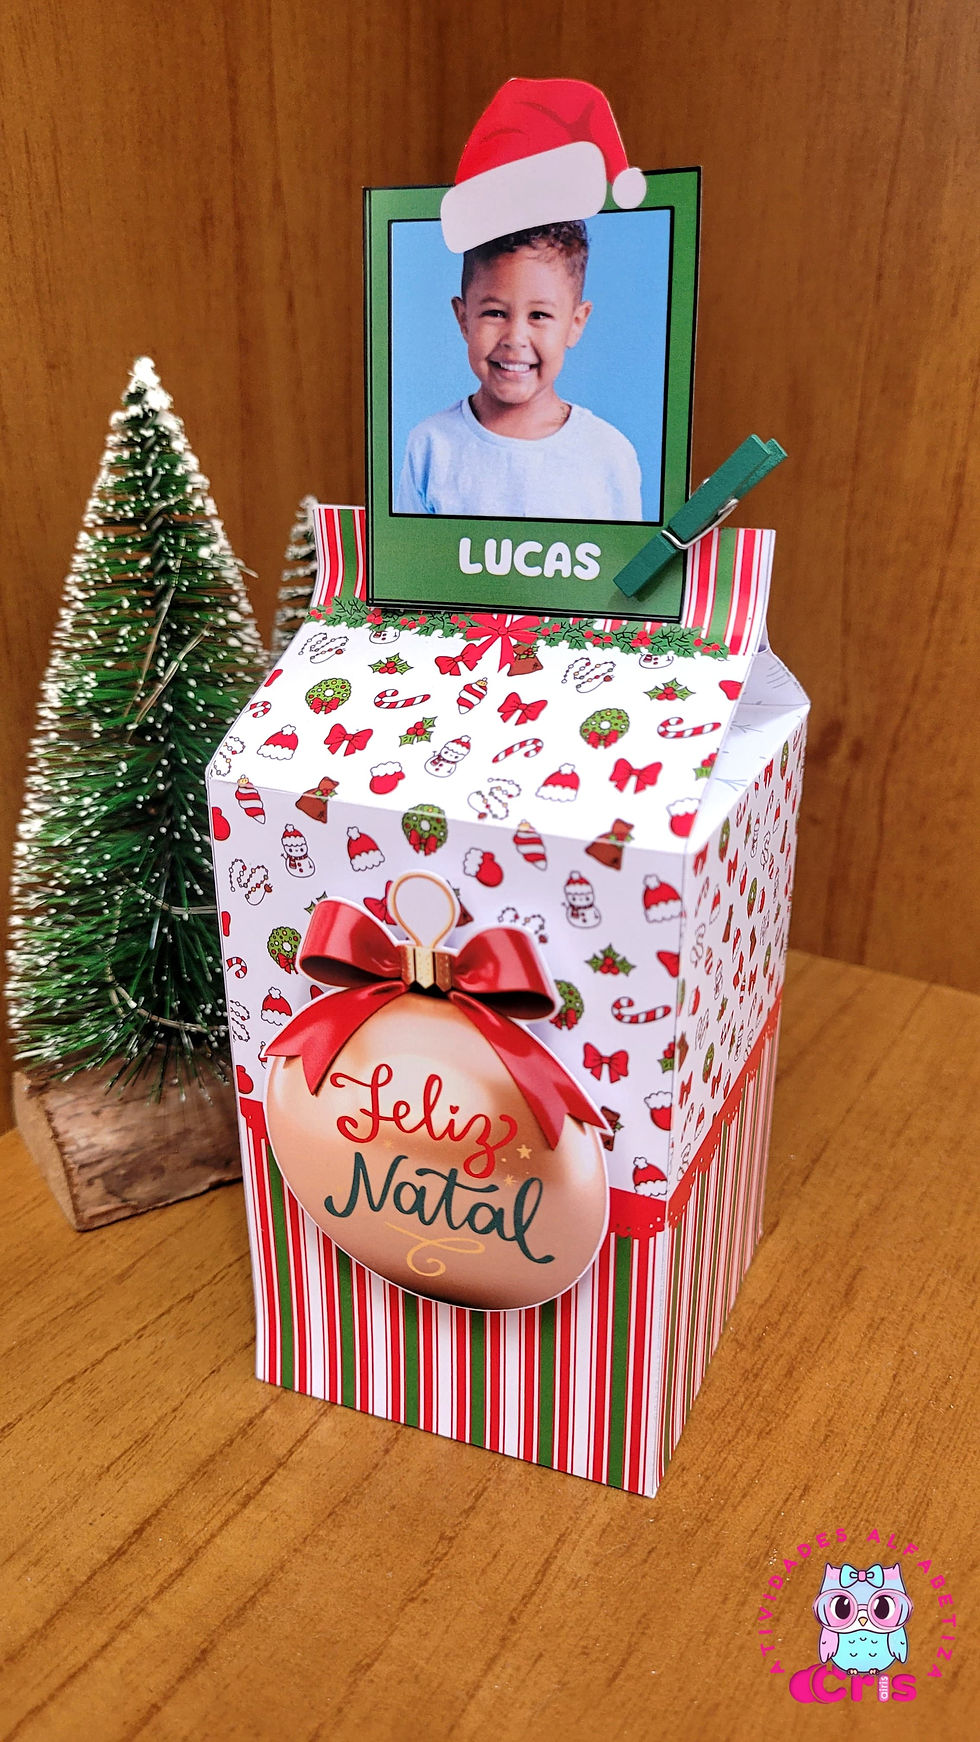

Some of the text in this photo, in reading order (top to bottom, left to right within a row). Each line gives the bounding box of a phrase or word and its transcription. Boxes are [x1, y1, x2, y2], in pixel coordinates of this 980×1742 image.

[459, 537, 602, 581] LUCAS
[329, 1063, 518, 1179] Feliz
[323, 1151, 556, 1265] Natal
